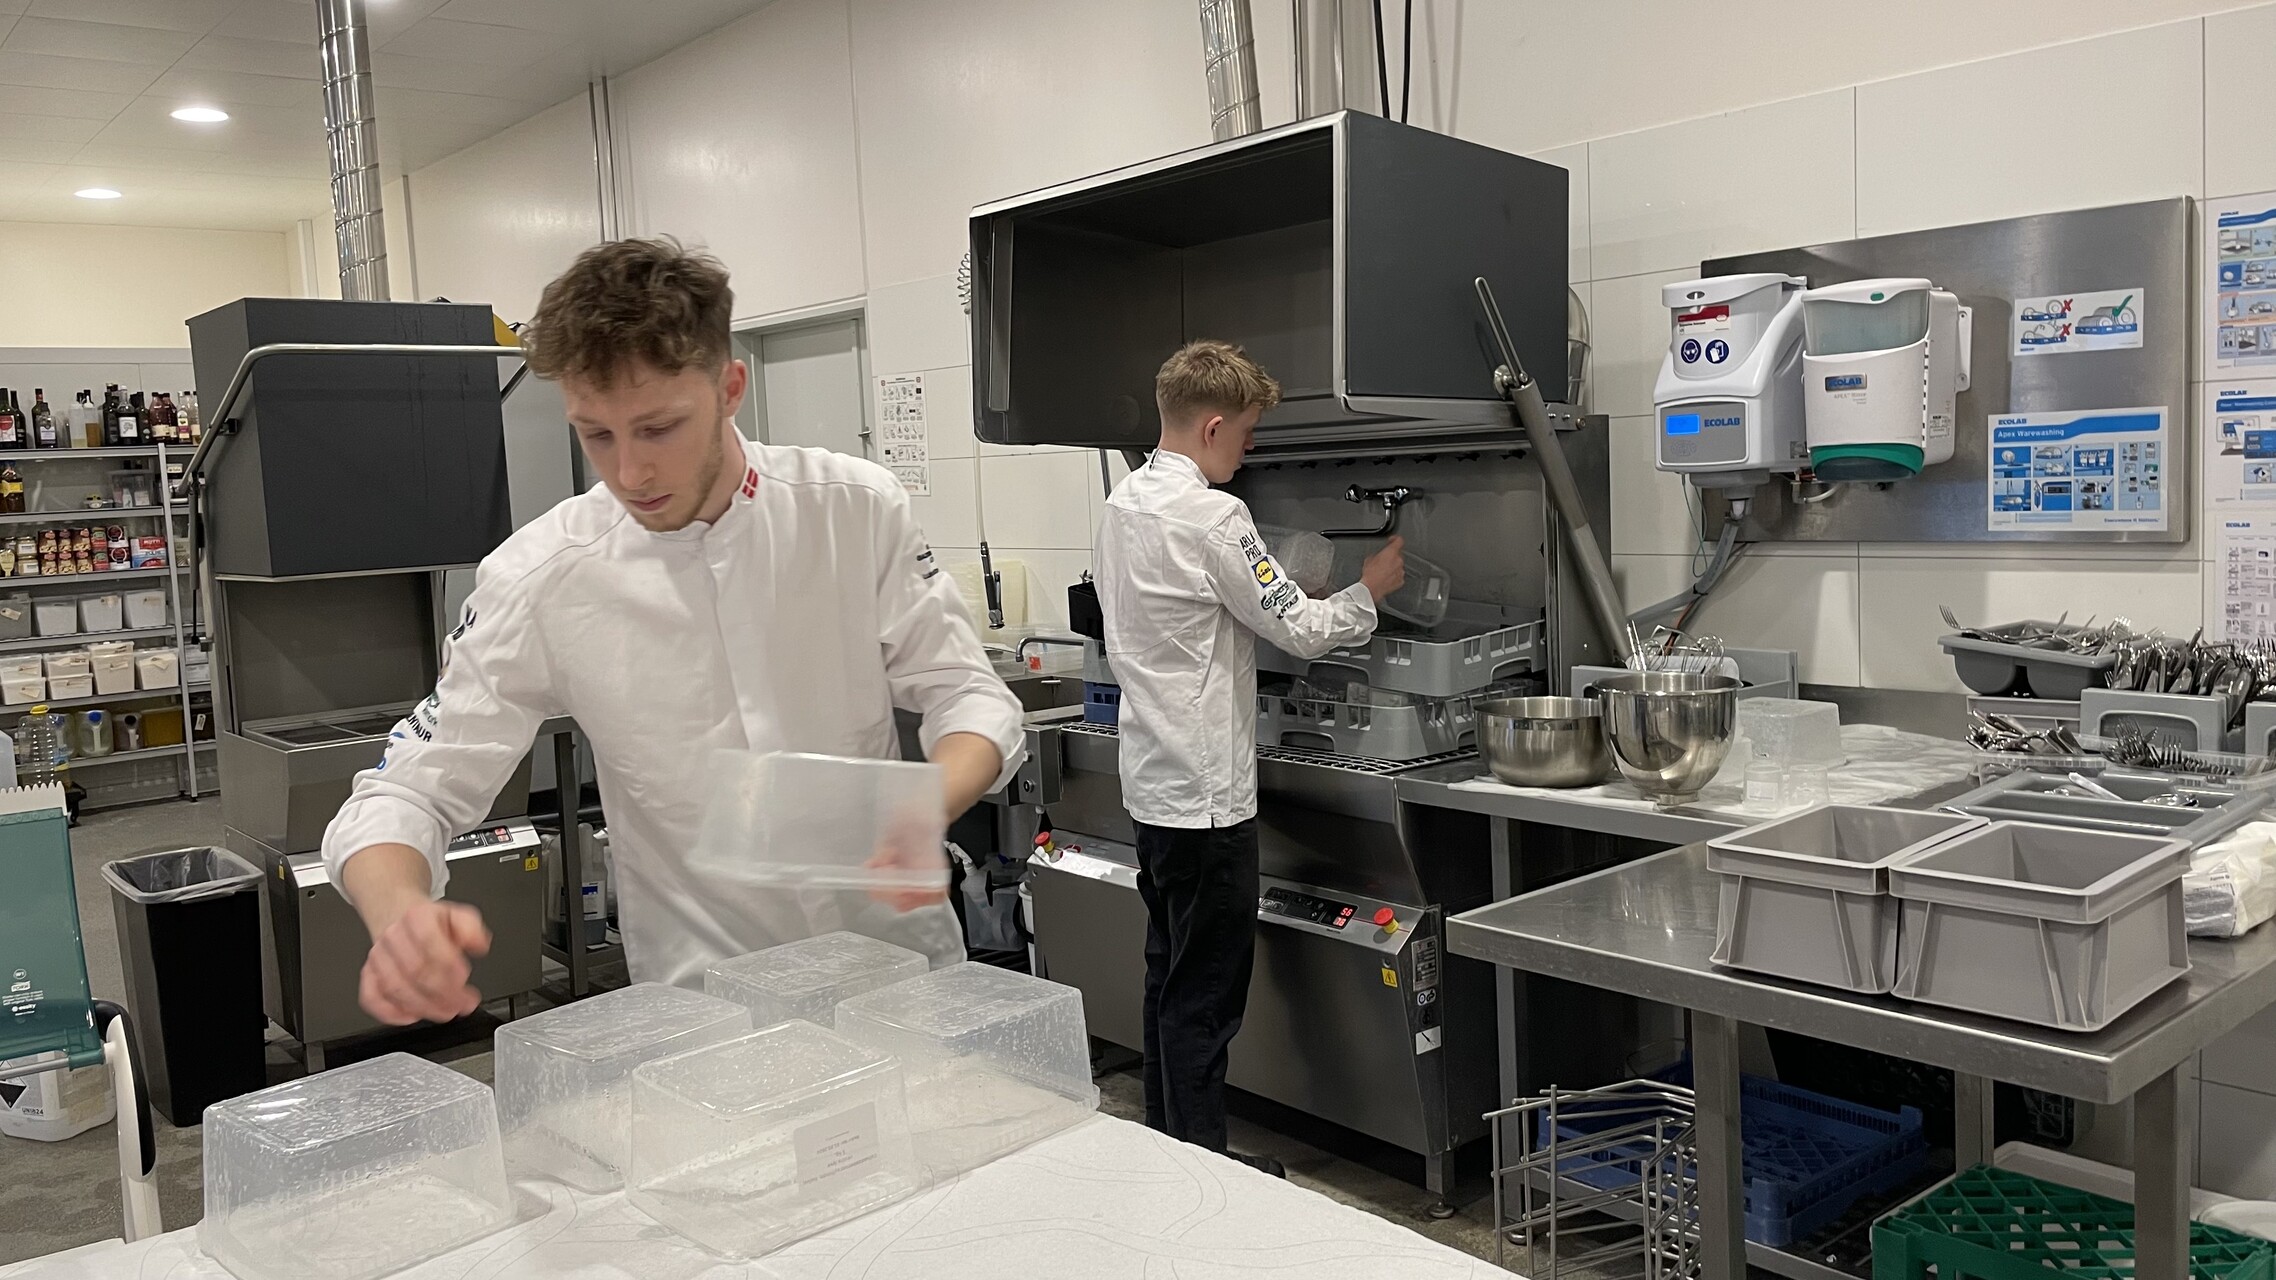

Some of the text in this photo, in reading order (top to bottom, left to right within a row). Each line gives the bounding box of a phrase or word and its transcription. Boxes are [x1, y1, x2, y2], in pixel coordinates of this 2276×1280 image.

[1704, 417, 1740, 428] ECOLAB
[1997, 428, 2065, 438] Apex Warewashing
[1245, 544, 1261, 561] PRO
[1276, 594, 1299, 621] KNTAU
[1340, 907, 1353, 917] 56
